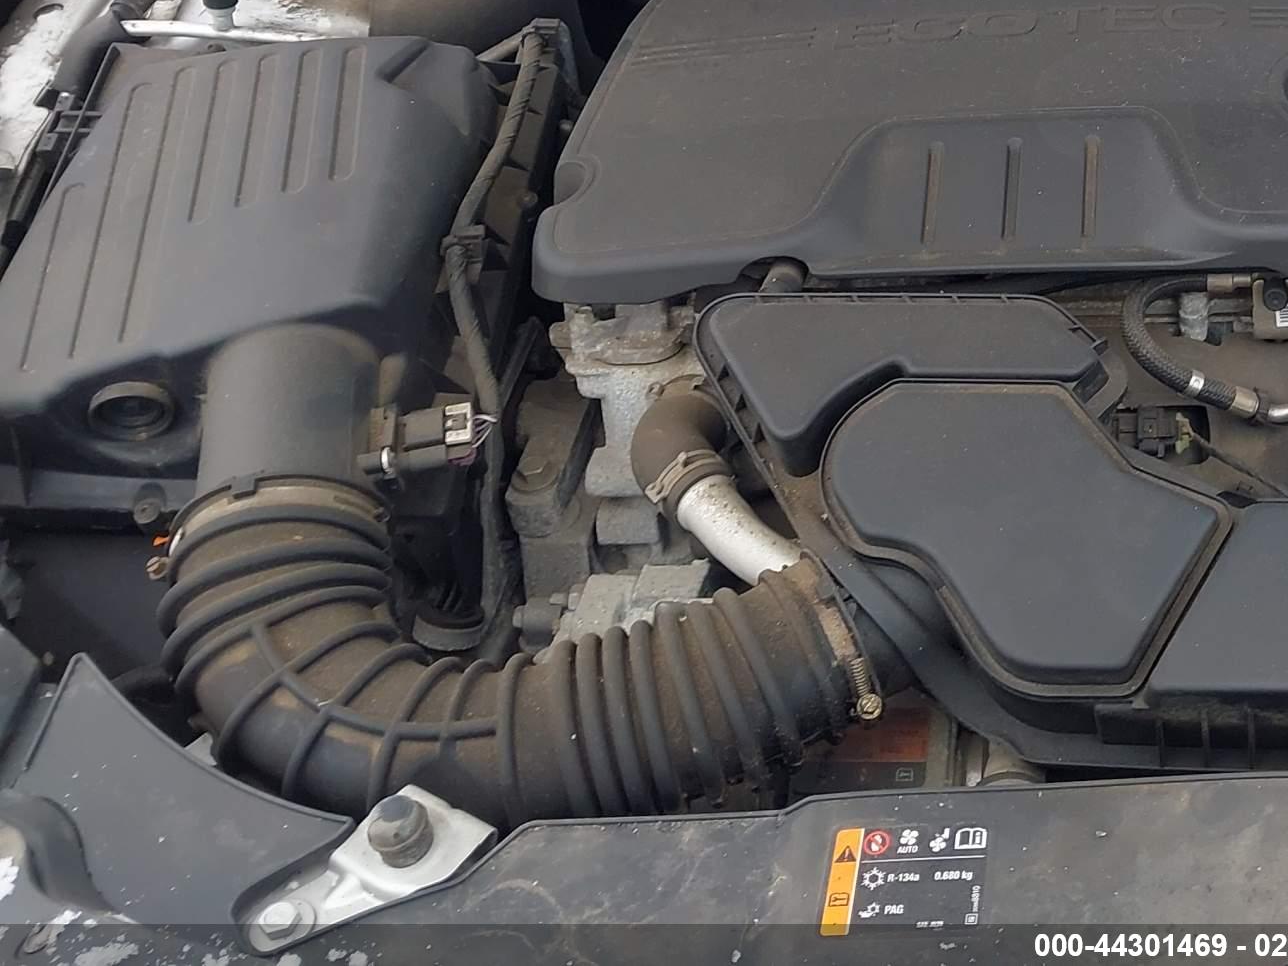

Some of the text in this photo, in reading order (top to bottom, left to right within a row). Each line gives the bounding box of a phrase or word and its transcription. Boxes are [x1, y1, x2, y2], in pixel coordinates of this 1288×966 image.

[835, 3, 1228, 50] ECOTEC
[897, 845, 919, 854] AUTO
[887, 873, 920, 883] R-134a
[961, 870, 973, 881] kg
[884, 904, 904, 915] PAG
